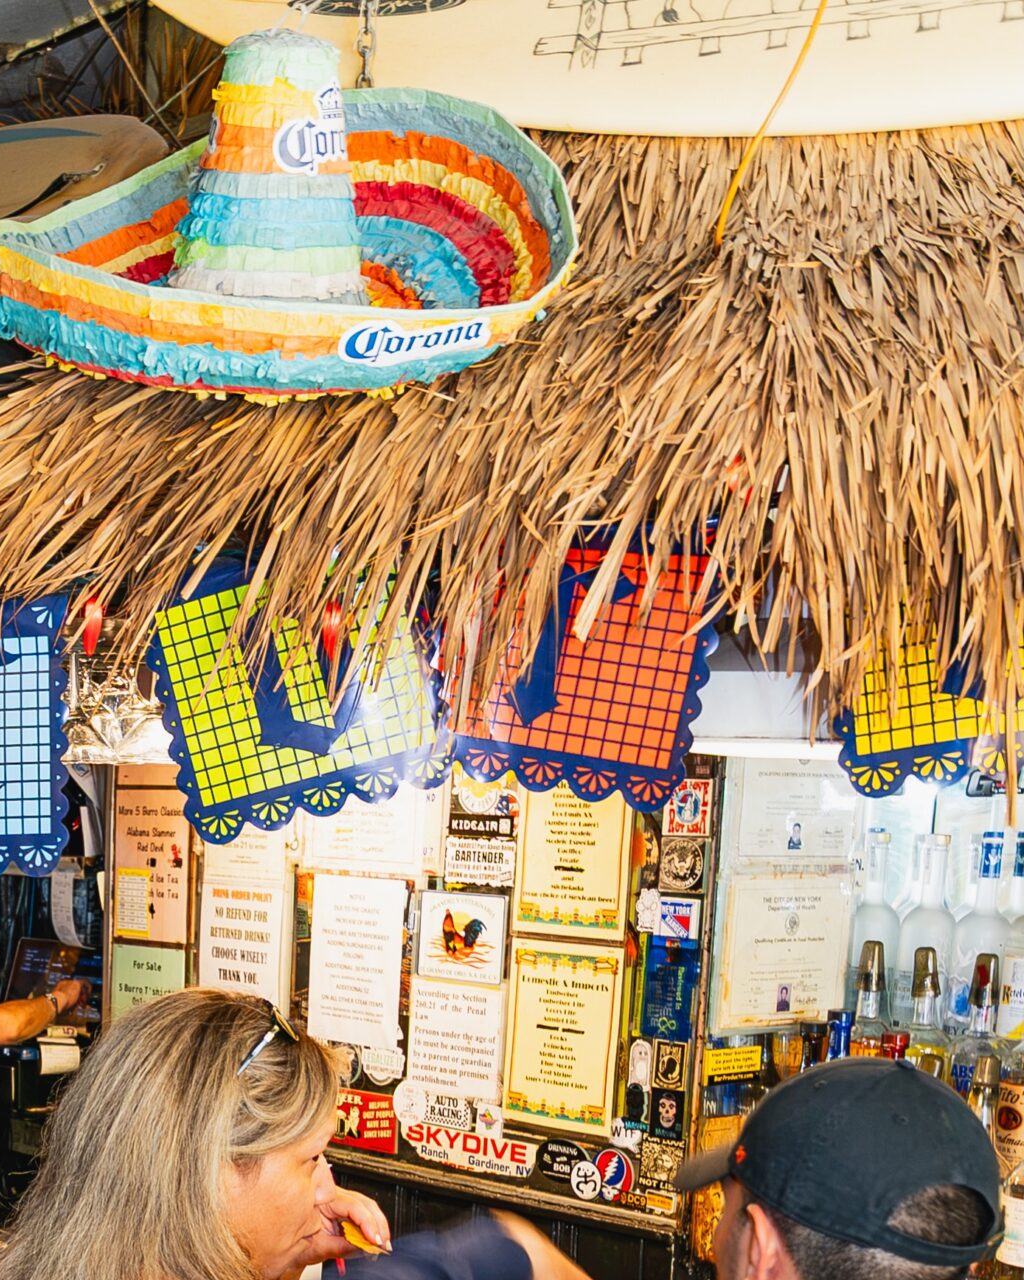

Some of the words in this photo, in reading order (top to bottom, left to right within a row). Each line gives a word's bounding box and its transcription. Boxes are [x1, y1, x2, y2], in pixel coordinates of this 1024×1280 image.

[345, 321, 483, 362] Corona
[118, 805, 133, 815] More
[136, 806, 140, 816] 5
[142, 806, 158, 816] Burro
[127, 827, 150, 837] Alabama
[152, 827, 176, 837] Slammer
[455, 850, 504, 864] BARTENDER
[168, 874, 178, 884] Tea
[167, 889, 178, 899] Tea
[231, 889, 250, 901] ORDER
[252, 891, 272, 903] POLICY
[215, 906, 223, 918] NO
[226, 907, 252, 921] REFUND
[254, 910, 268, 923] FOR
[675, 904, 692, 915] YORK
[210, 926, 242, 940] RETURNED
[245, 930, 271, 943] DRINKS!
[212, 946, 237, 960] CHOOSE
[240, 949, 268, 964] WISELY!
[133, 960, 144, 969] For
[146, 961, 162, 972] Sale
[218, 968, 241, 982] THANK
[243, 971, 259, 985] YOU.
[522, 975, 558, 986] Domestic
[571, 981, 609, 992] Imports
[124, 984, 143, 994] Burro
[417, 989, 449, 1000] According
[462, 994, 487, 1004] Section
[416, 1000, 436, 1009] 260.21
[452, 1005, 463, 1013] the
[467, 1006, 486, 1016] Penal
[415, 1012, 428, 1020] Law
[414, 1026, 440, 1036] Persons
[441, 1030, 460, 1039] under
[463, 1032, 474, 1040] the
[476, 1035, 486, 1043] age
[488, 1036, 496, 1044] of
[423, 1040, 439, 1048] must
[441, 1041, 448, 1050] be
[450, 1043, 495, 1056] accompanied
[413, 1050, 421, 1058] by
[428, 1053, 450, 1061] parent
[461, 1057, 492, 1069] guardian
[420, 1063, 438, 1072] enter
[459, 1068, 489, 1080] premises
[411, 1074, 459, 1087] establishment.
[369, 1101, 389, 1109] HELPING
[435, 1095, 458, 1108] AUTO
[430, 1106, 462, 1120] RACING
[366, 1120, 379, 1128] HAVE
[380, 1120, 390, 1128] SEX
[406, 1123, 527, 1164] SKYDIVE
[548, 1143, 578, 1156] DRINKING
[421, 1145, 449, 1159] Ranch
[516, 1165, 532, 1176] NY
[553, 1163, 570, 1173] BOB
[640, 1177, 658, 1187] NOT
[627, 1194, 646, 1206] DC9
